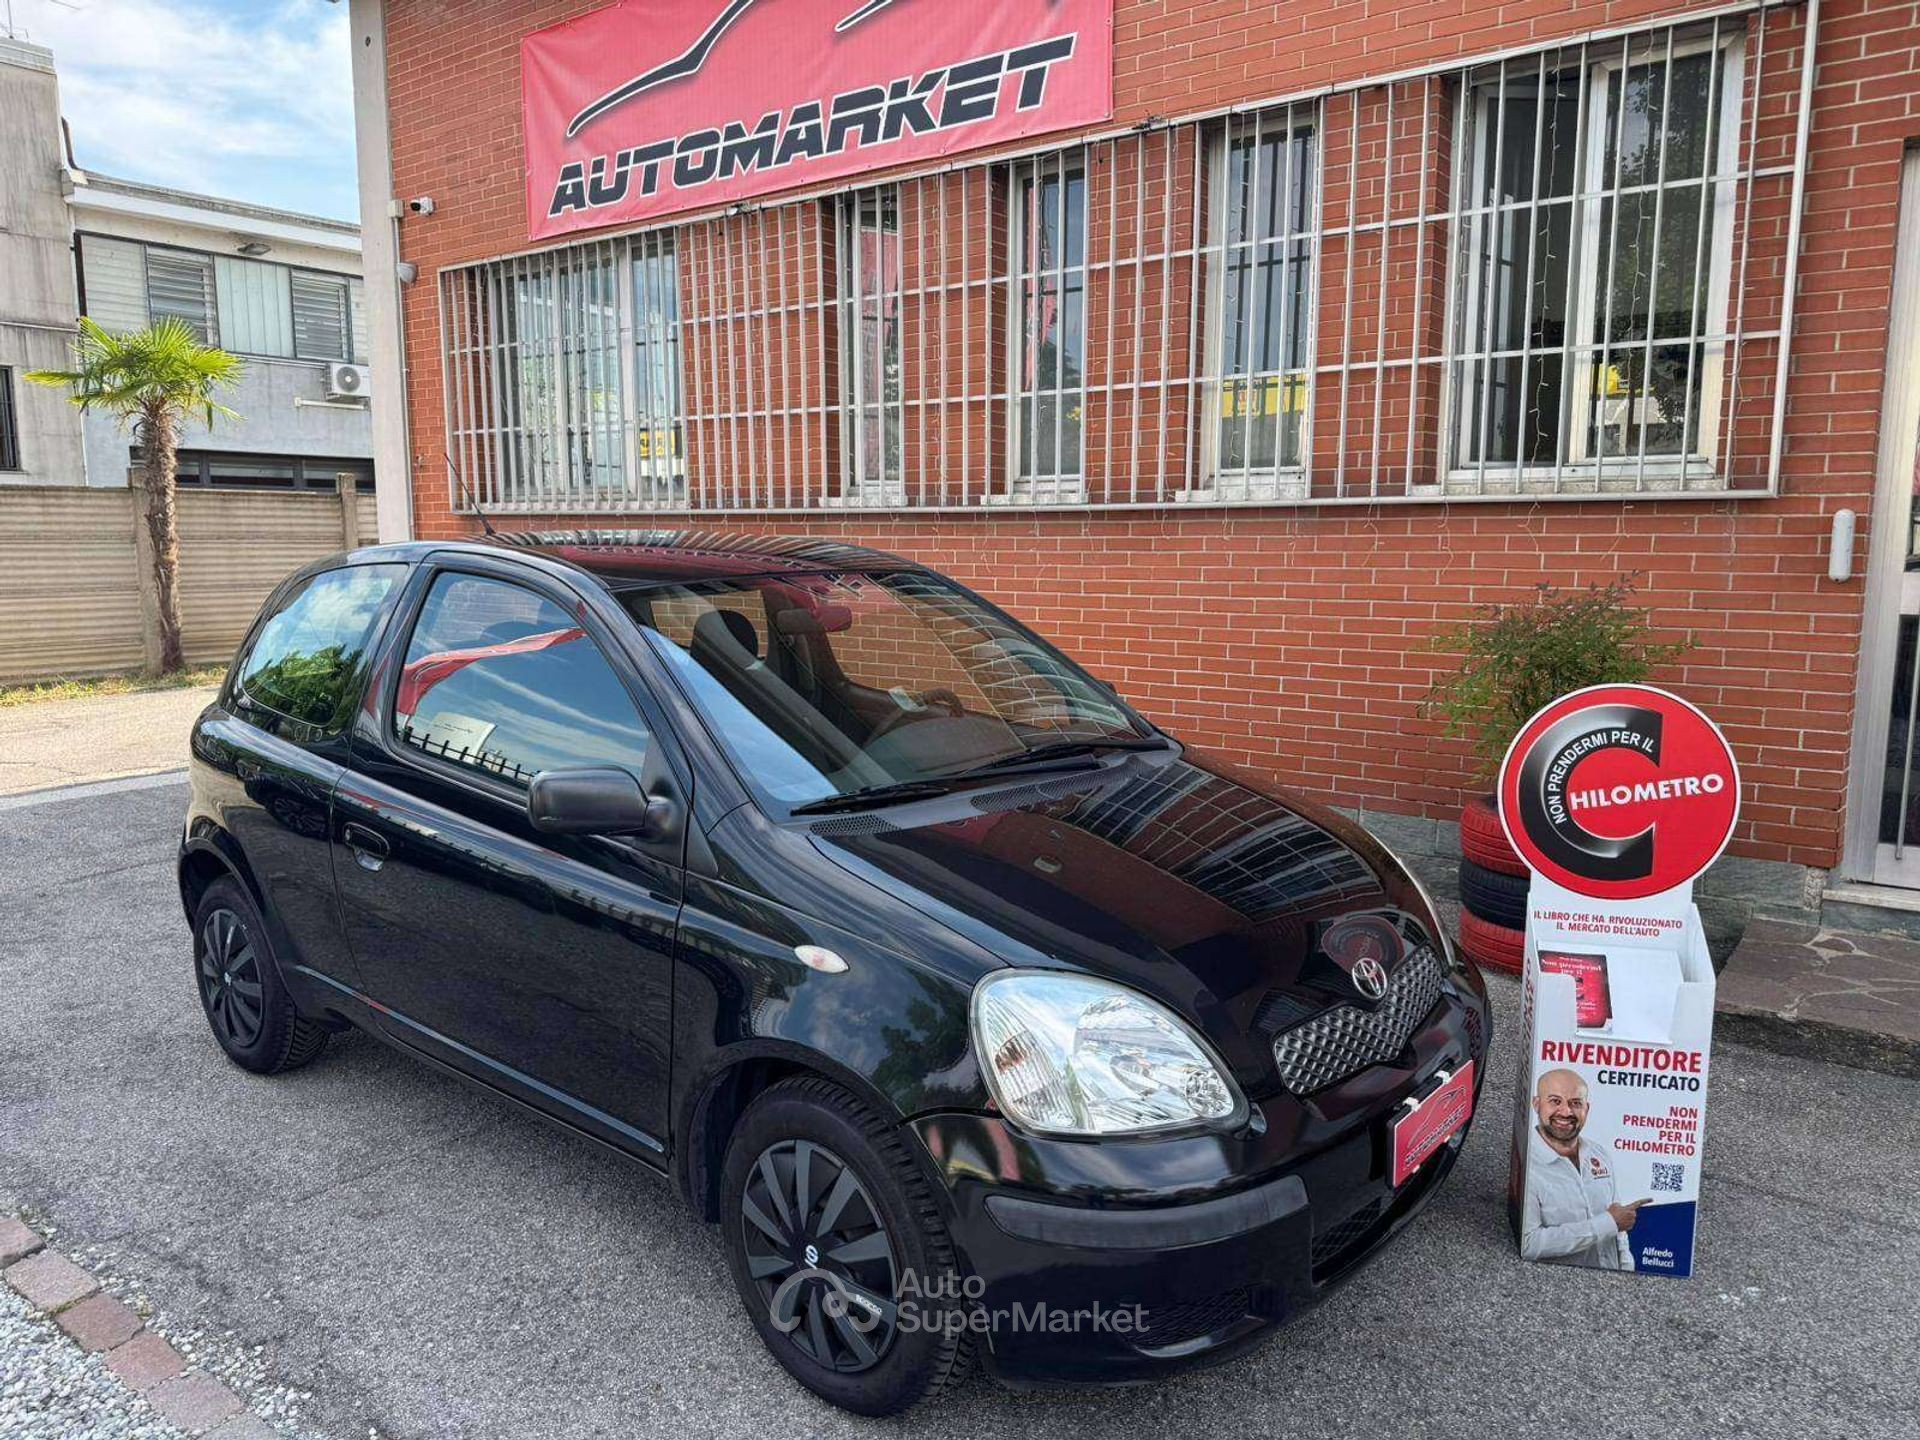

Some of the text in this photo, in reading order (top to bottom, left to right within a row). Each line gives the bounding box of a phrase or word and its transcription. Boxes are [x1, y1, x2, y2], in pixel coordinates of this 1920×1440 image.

[548, 32, 1078, 217] AUTOMARKET
[1548, 730, 1655, 825] NON PRENDERMI PER IL
[1533, 910, 1683, 929] IL LIBRO CHE HA RIVOLUZIONATO
[1556, 921, 1660, 937] IL MERCATO DELL'AUTO
[1541, 1040, 1702, 1073] RIVENDITORE
[1597, 1069, 1700, 1092] CERTIFICATO
[1669, 1106, 1698, 1119] NON
[1623, 1114, 1697, 1131] PRENDERMI
[1659, 1130, 1696, 1144] PER IL
[1614, 1138, 1695, 1156] CHILOMETRO
[1642, 1246, 1673, 1258] Alfredo
[1642, 1256, 1674, 1268] Bellucci
